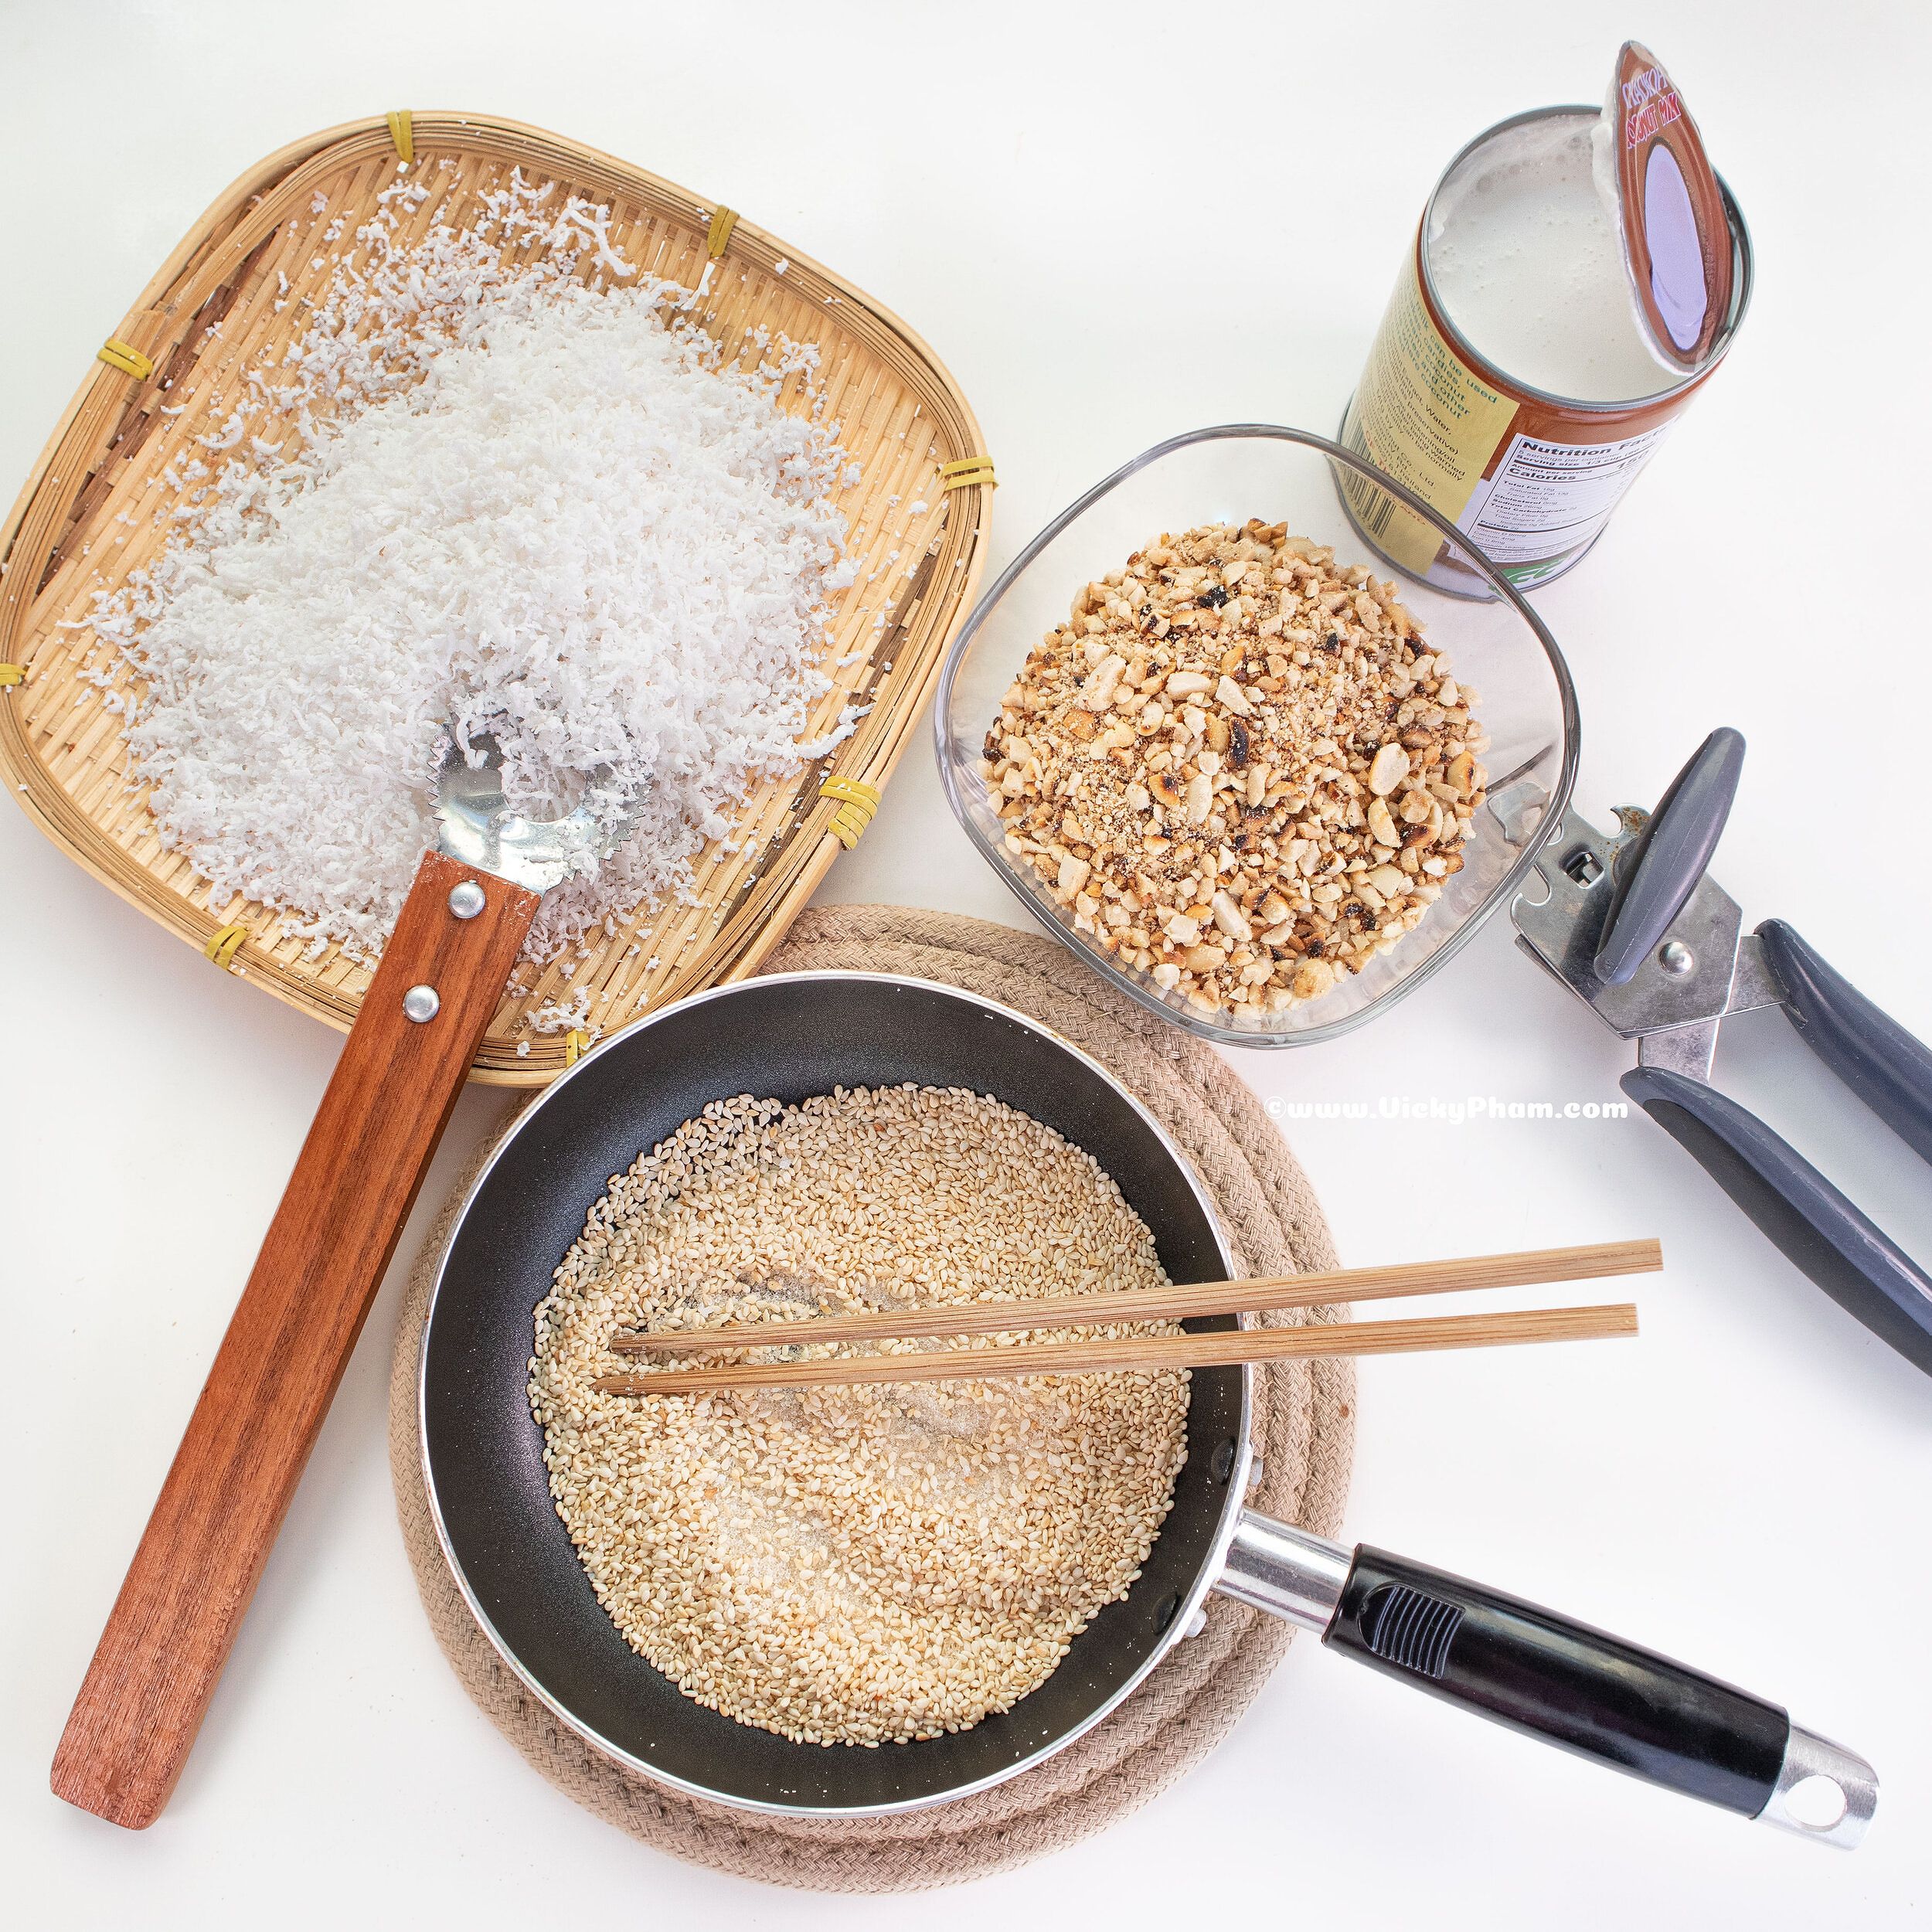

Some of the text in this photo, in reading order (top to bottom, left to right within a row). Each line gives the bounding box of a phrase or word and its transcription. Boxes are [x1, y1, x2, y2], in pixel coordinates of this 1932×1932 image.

[1423, 335, 1461, 388] candies,
[1430, 334, 1446, 359] can
[1448, 359, 1462, 376] be
[1466, 379, 1498, 403] used
[1425, 353, 1466, 401] coconut
[1420, 372, 1462, 419] coconut
[1421, 361, 1437, 385] and
[1440, 385, 1470, 415] other
[1385, 413, 1393, 431] by
[1424, 404, 1452, 435] Water,
[1406, 412, 1455, 463] thickening/oil
[1409, 403, 1458, 455] preservative)
[1410, 425, 1429, 450] being
[1430, 449, 1465, 476] warmed
[1522, 441, 1611, 456] Nutrition
[1526, 453, 1562, 462] servings
[1425, 452, 1462, 481] normally
[1512, 463, 1543, 473] Amount
[1516, 454, 1555, 466] Serving
[1396, 463, 1431, 499] Thailand
[1419, 471, 1437, 488] Ltd.
[1509, 468, 1577, 480] Calories
[1503, 480, 1524, 488] Total
[1491, 502, 1512, 511] Total
[1492, 498, 1522, 507] Sodium
[1495, 494, 1542, 505] Cholesterol
[1481, 519, 1509, 529] Protein
